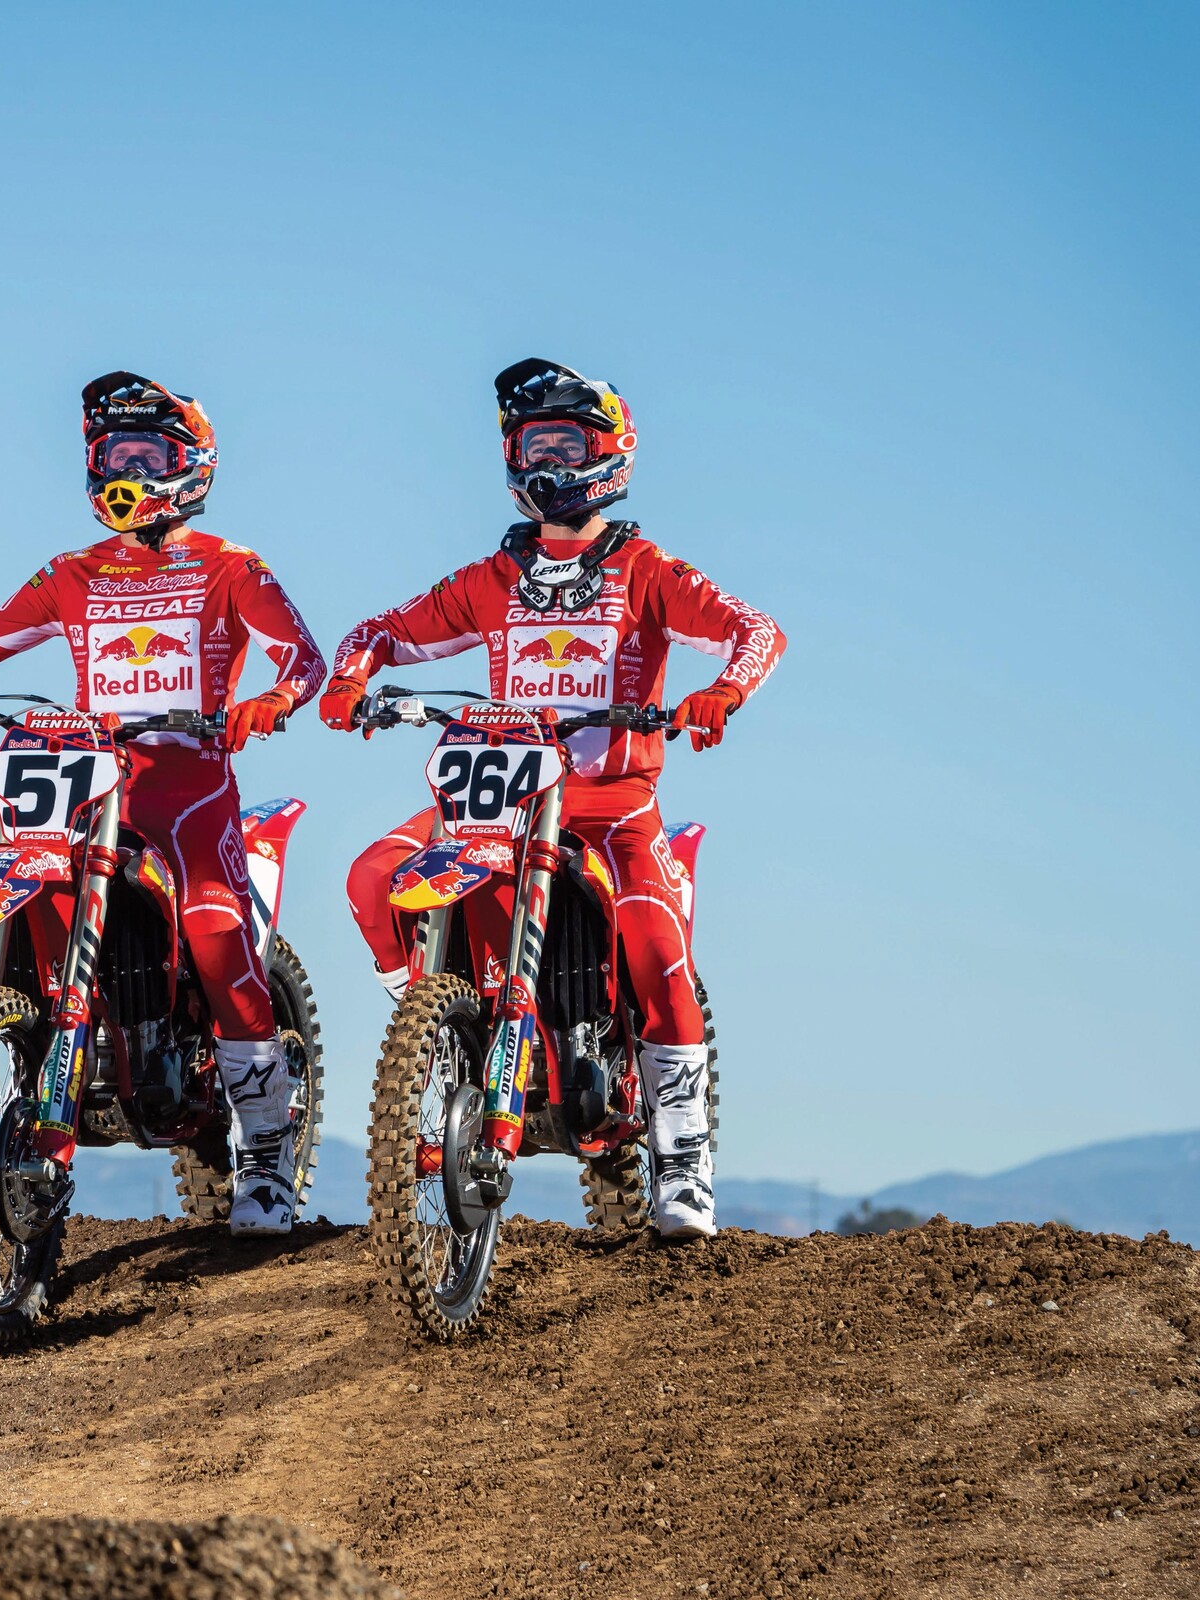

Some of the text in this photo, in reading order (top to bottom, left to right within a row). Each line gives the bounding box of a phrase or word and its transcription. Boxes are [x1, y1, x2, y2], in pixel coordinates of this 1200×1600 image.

[587, 471, 617, 501] Red
[168, 560, 202, 570] MOTOREX
[532, 561, 577, 578] LEATT
[89, 573, 208, 595] Troy Lee Designs
[523, 582, 549, 605] SIPES
[569, 581, 594, 606] 264
[85, 596, 206, 619] GASGAS
[505, 606, 624, 624] GASGAS
[92, 668, 193, 696] Red Bull
[510, 672, 607, 699] Red Bull
[8, 739, 42, 749] Red Bull
[447, 734, 482, 744] Red Bull
[3, 755, 96, 830] 51
[438, 750, 543, 822] 264
[19, 832, 63, 841] GASGAS
[53, 1035, 72, 1107] DUNLOP
[501, 1025, 519, 1098] DUNLOP
